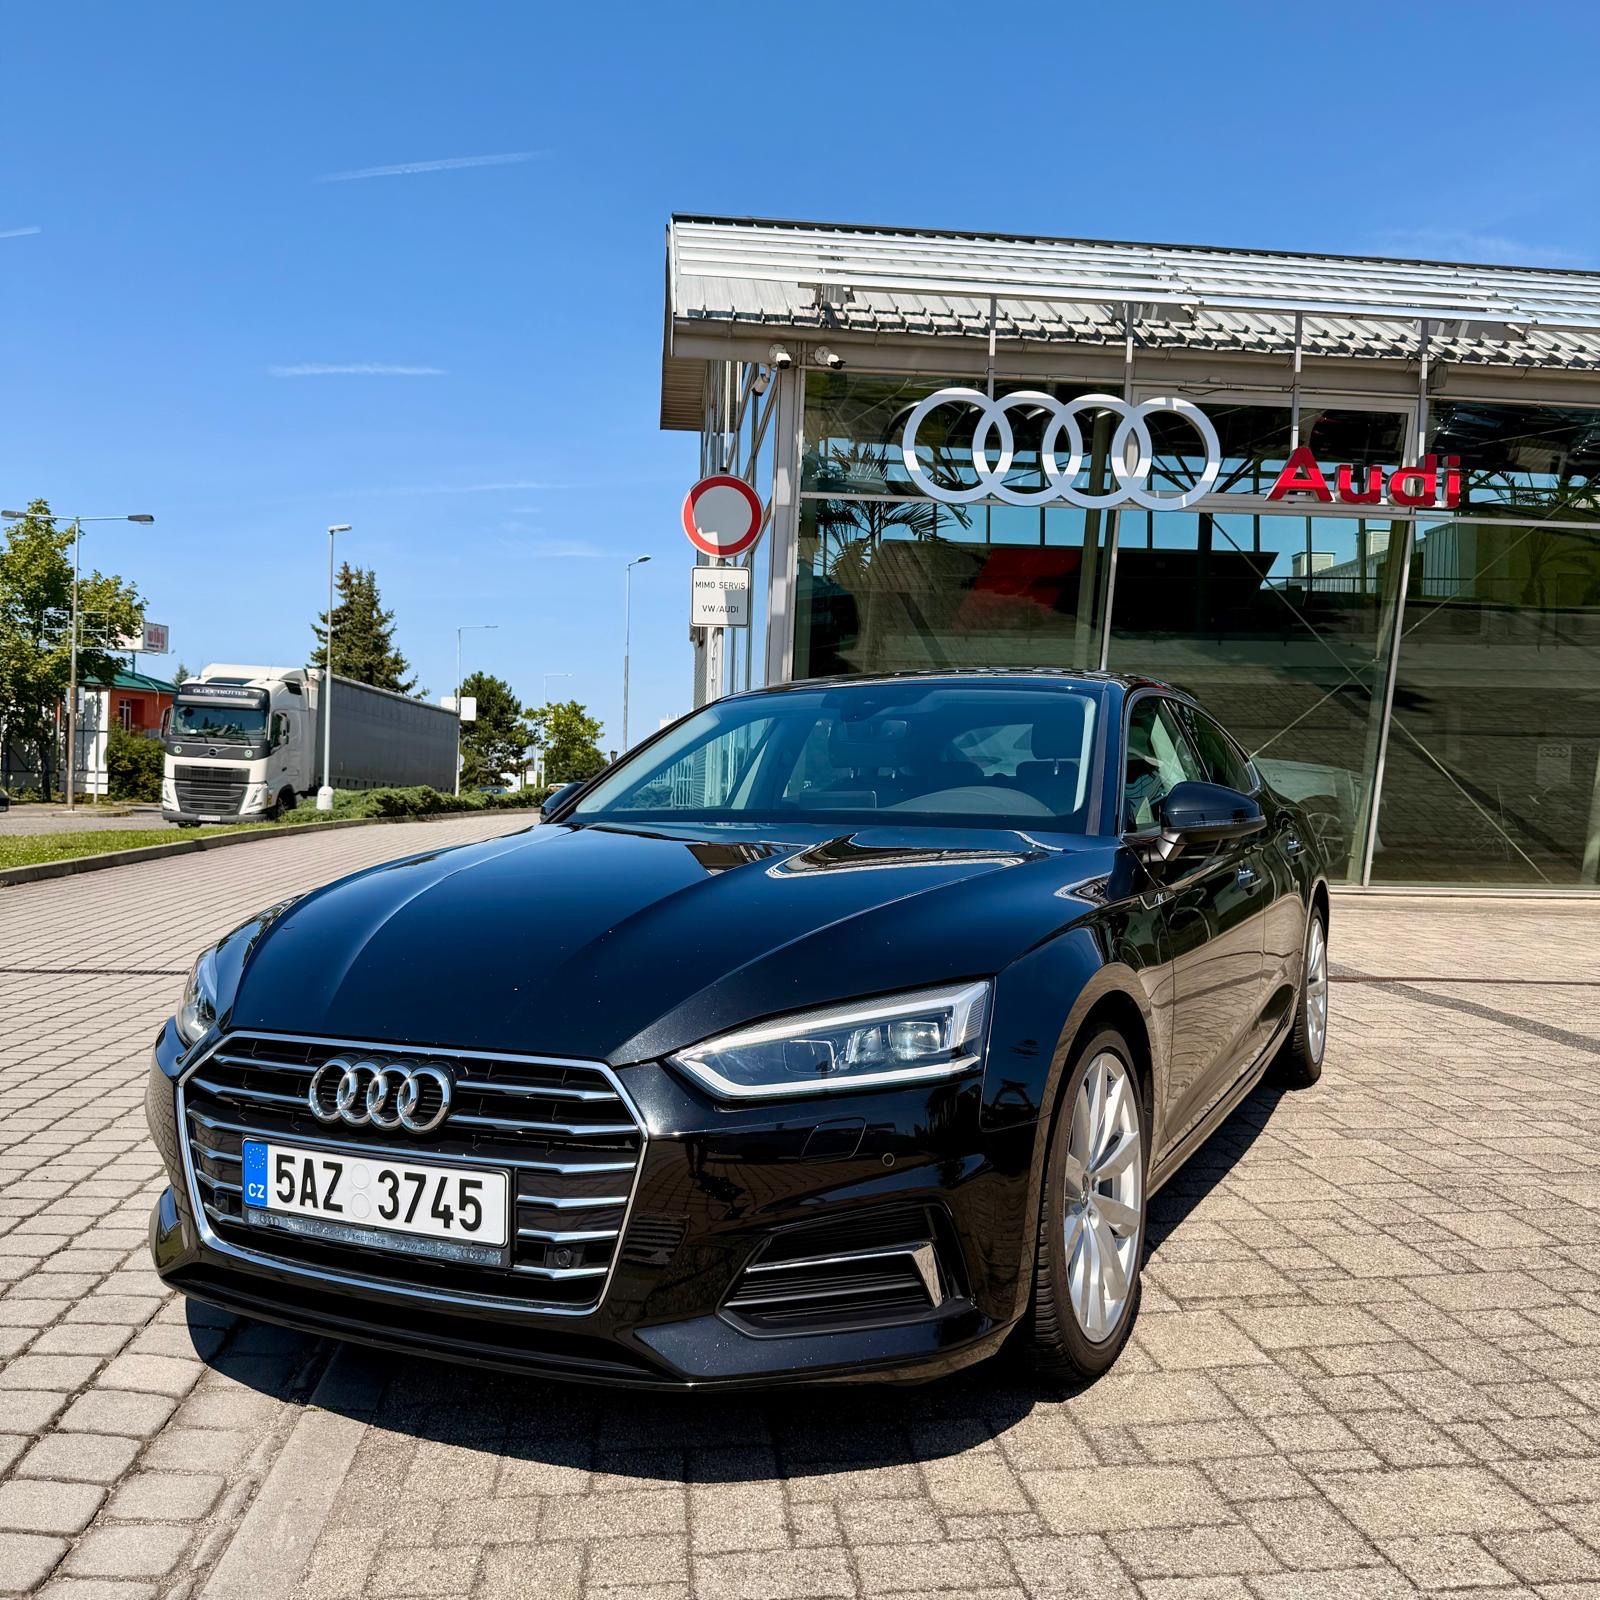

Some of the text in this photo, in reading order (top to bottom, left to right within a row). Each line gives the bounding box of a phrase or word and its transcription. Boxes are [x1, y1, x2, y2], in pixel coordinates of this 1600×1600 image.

[1265, 447, 1461, 508] Audi
[718, 582, 746, 590] SERVIS
[702, 605, 739, 614] VW/AUDI
[248, 1183, 265, 1199] CZ
[276, 1153, 483, 1232] 5AZ 3745
